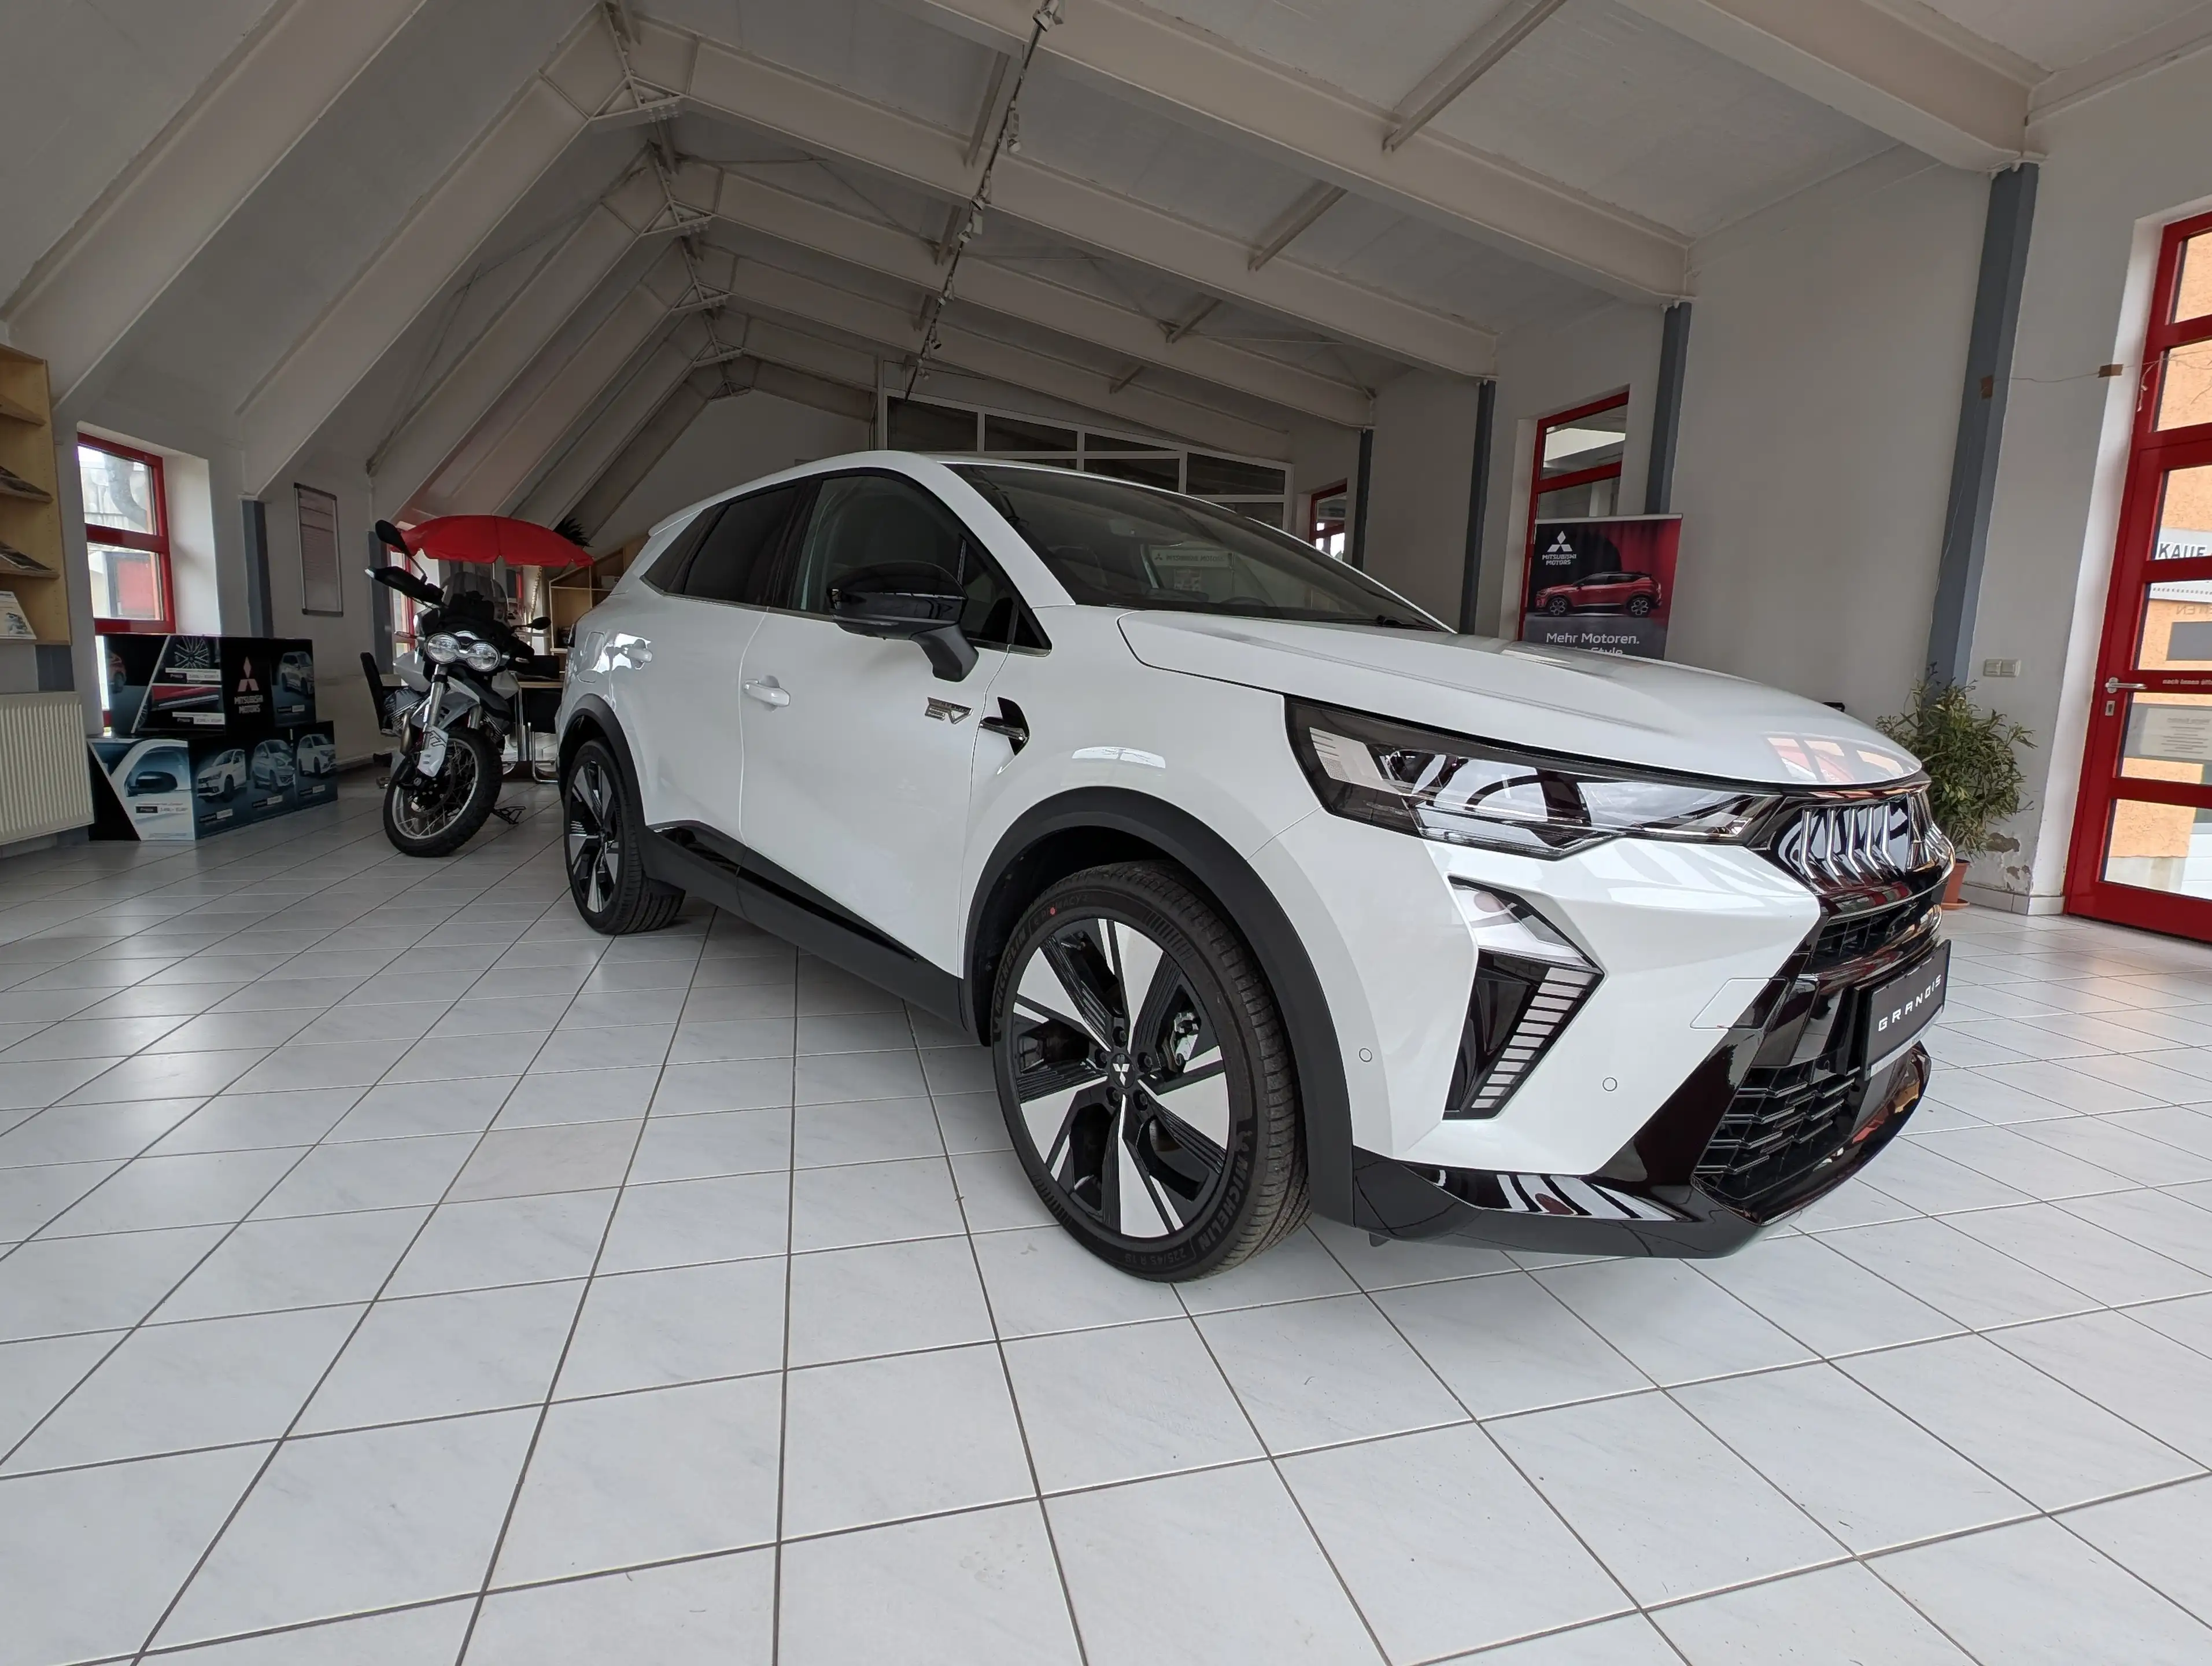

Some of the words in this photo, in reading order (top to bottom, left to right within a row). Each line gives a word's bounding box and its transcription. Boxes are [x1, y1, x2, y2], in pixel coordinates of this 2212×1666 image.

[1546, 633, 1578, 643] Mehr
[1581, 633, 1640, 644] Motoren.
[1878, 974, 1941, 1031] GRANDIS
[1200, 1154, 1250, 1252] MICHELIN
